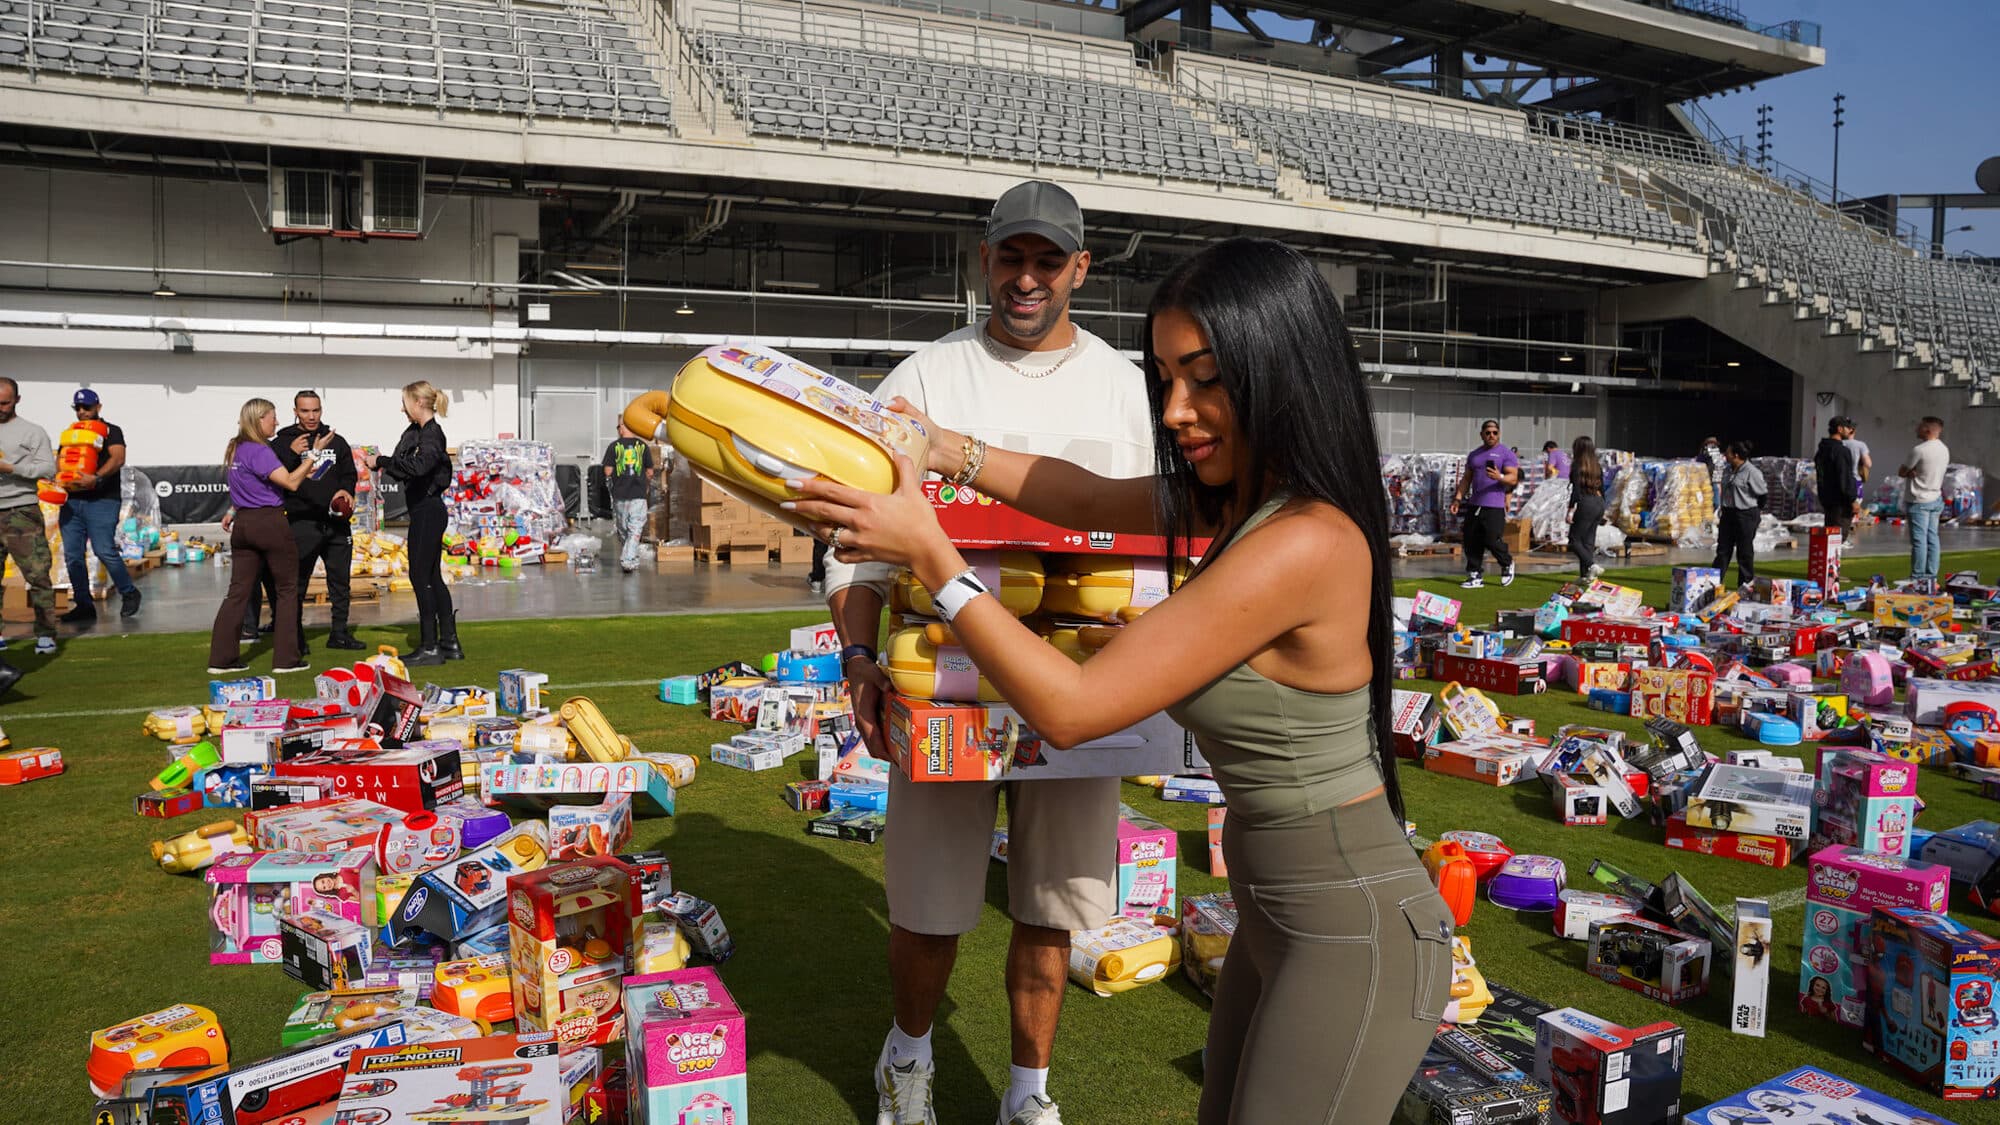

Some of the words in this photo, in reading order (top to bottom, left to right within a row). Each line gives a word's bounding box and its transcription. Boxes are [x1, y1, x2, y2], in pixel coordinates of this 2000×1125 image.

[175, 483, 230, 493] STADIUM
[1064, 535, 1083, 546] 6+
[1586, 628, 1638, 640] TYSON
[1457, 661, 1505, 678] TYSON
[931, 720, 940, 771] TOP-NOTCH
[1825, 866, 1847, 880] ICE
[630, 876, 640, 884] 3+
[1814, 875, 1857, 892] CREAM
[1820, 886, 1849, 898] STOP
[1906, 882, 1920, 892] 3+
[1862, 888, 1877, 896] Run
[1879, 891, 1895, 900] Your
[1897, 896, 1915, 904] Own
[1872, 898, 1896, 906] Cream
[405, 891, 425, 916] Ford
[1818, 914, 1835, 925] 27
[265, 943, 276, 956] 27
[552, 953, 567, 965] 35
[556, 1017, 596, 1035] BURGER
[1559, 1012, 1603, 1030] VENOM
[562, 1028, 588, 1040] STOP
[1564, 1020, 1623, 1044] TUMBLER
[682, 1032, 711, 1046] ICE
[370, 1050, 456, 1064] TOP-NOTCH
[669, 1041, 725, 1061] CREAM
[289, 1061, 315, 1074] MUSTANG
[316, 1056, 330, 1066] FORD
[679, 1057, 716, 1073] STOP
[268, 1069, 289, 1080] SHELBY
[249, 1076, 268, 1087] GT500
